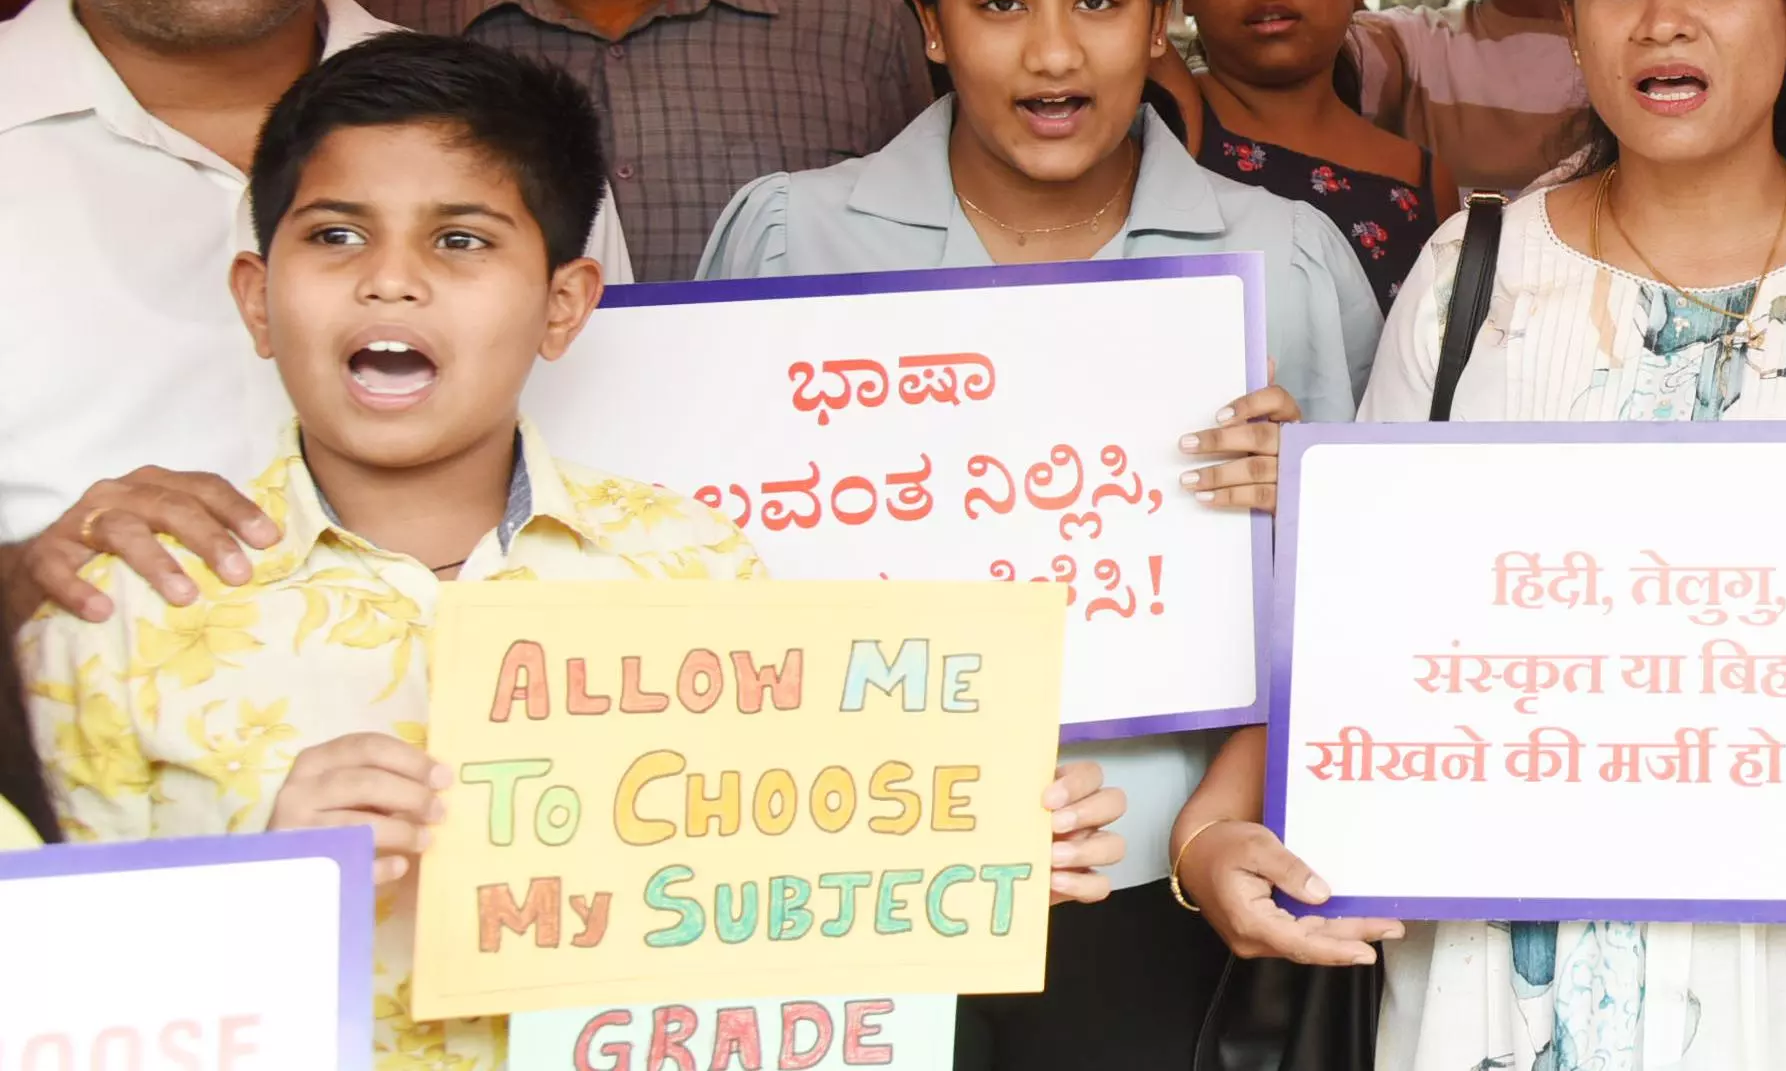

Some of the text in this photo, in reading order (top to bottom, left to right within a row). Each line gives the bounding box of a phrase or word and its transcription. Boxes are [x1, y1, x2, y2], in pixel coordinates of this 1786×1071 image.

[787, 351, 998, 426] ಭಾಷಾ
[1491, 549, 1614, 616] हिंदी,
[488, 637, 982, 723] ALLOW ME
[1413, 639, 1605, 715] संस्कृत
[1620, 653, 1683, 695] या
[1304, 724, 1490, 786] सीखने
[1503, 725, 1586, 785] की
[1597, 725, 1718, 785] मर्जी
[1728, 726, 1783, 787] हो
[612, 748, 981, 847] CHOOSE
[643, 863, 1033, 948] SUBJECT
[0, 1012, 264, 1071] OOSE
[572, 998, 897, 1071] GRADE
